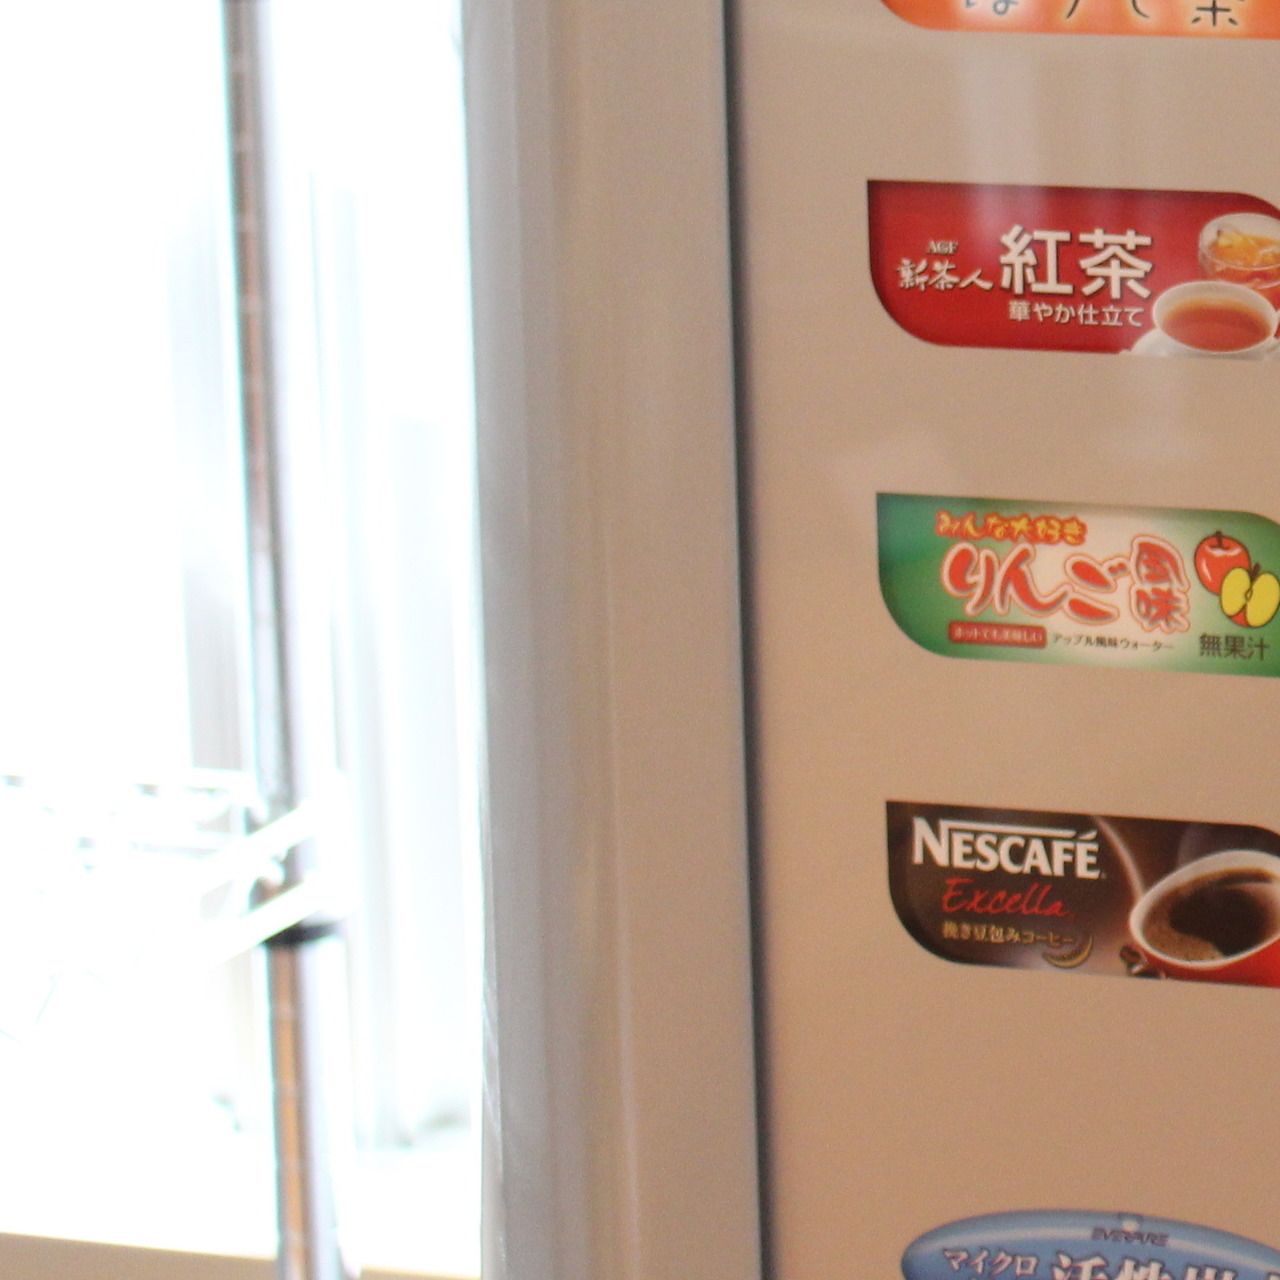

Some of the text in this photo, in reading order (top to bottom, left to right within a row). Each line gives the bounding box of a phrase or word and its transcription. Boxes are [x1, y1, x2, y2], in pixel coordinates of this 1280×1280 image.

[896, 258, 994, 292] 新茶人
[1000, 224, 1153, 299] 紅茶
[1008, 298, 1144, 328] 華やか仕立て
[936, 509, 1087, 546] みんな大好き
[1198, 632, 1271, 661] 無果汁
[911, 816, 1101, 880] NESCAFÉ
[941, 876, 1070, 917] Excella
[942, 1246, 1039, 1276] マイクロ
